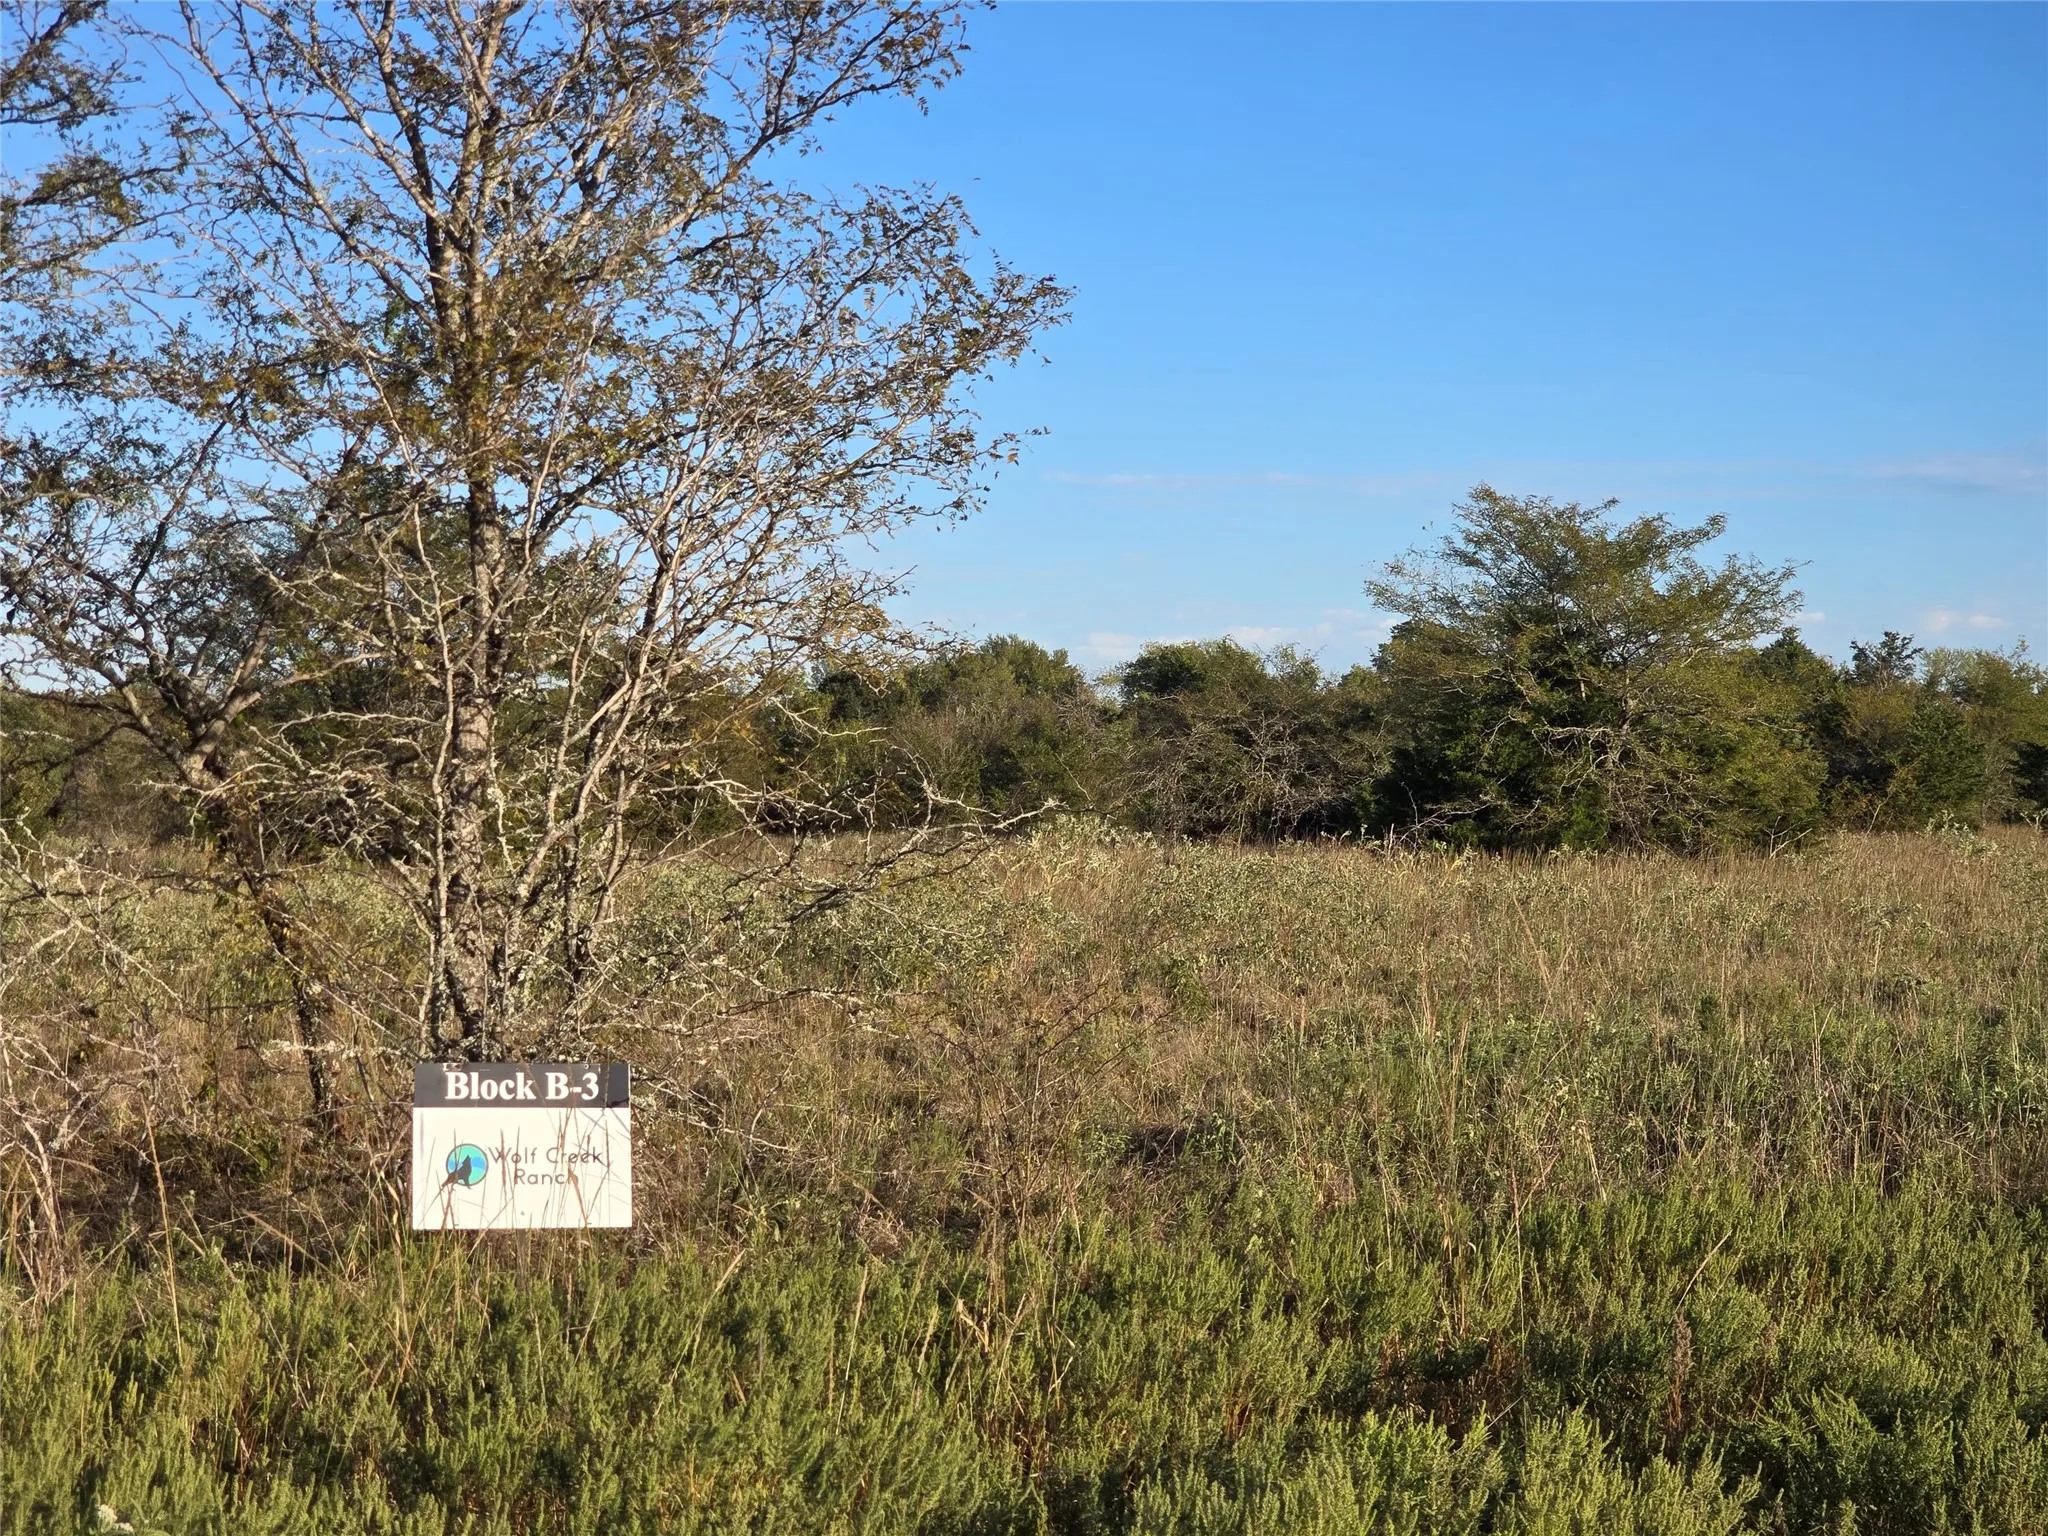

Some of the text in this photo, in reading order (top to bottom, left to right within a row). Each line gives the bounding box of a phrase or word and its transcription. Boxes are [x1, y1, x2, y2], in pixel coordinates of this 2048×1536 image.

[445, 1072, 599, 1100] Block B-3
[488, 1146, 602, 1164] Wolf Creek
